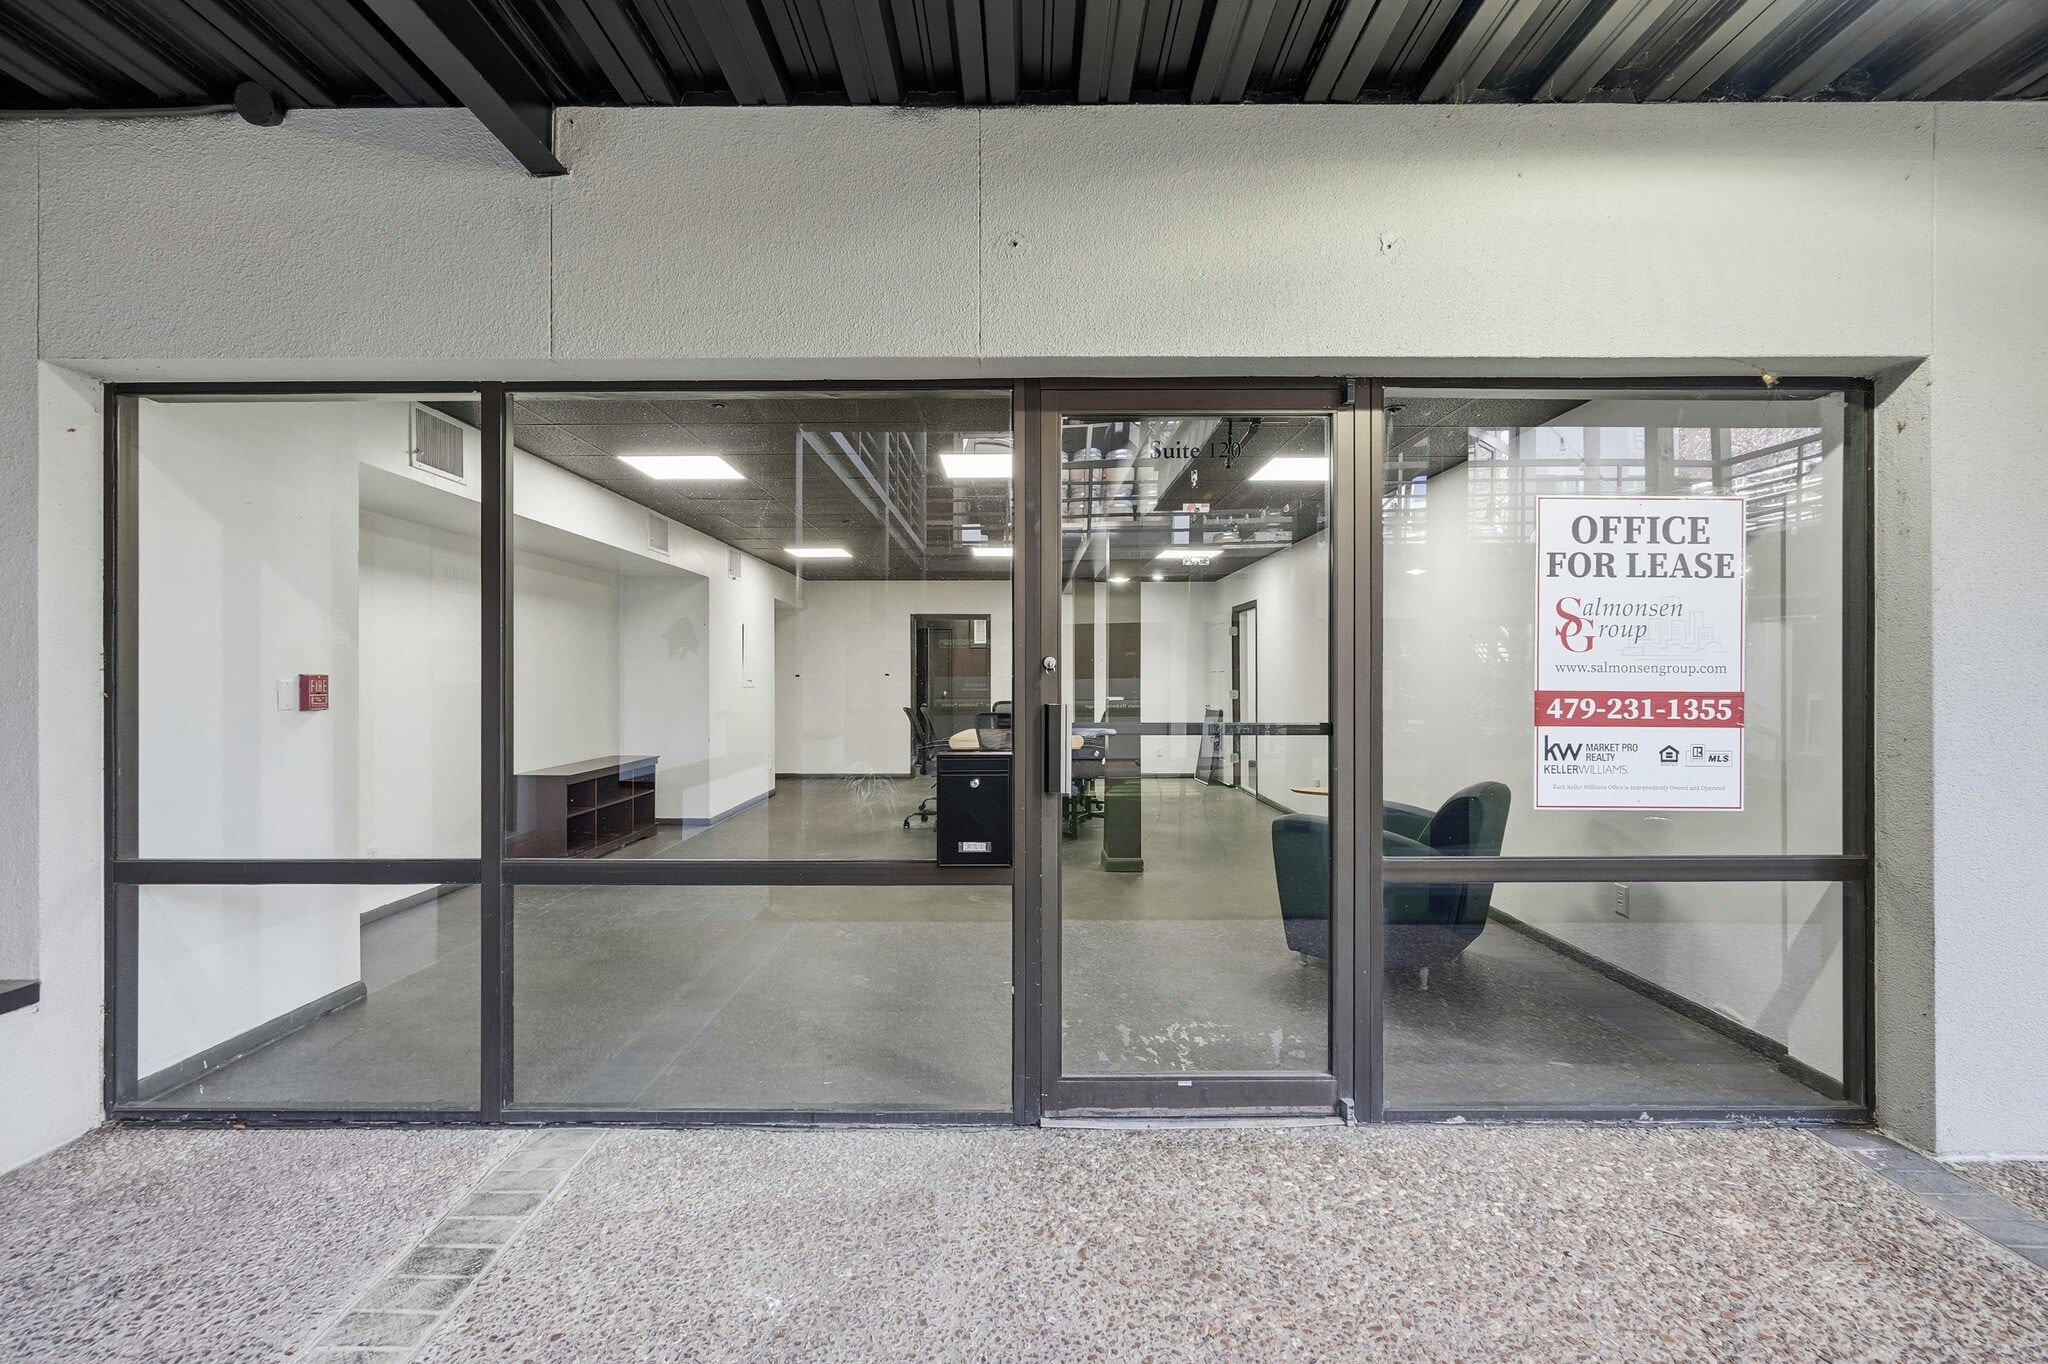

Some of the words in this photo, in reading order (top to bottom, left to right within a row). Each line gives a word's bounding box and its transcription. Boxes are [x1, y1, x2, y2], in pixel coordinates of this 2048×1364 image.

[1150, 440, 1201, 459] Suite
[1209, 441, 1242, 459] 120
[1571, 515, 1711, 545] OFFICE
[1546, 552, 1618, 579] FOR
[1626, 552, 1735, 579] LEASE
[1555, 596, 1684, 637] Salmonsen
[1560, 617, 1648, 653] Group
[1555, 661, 1728, 677] www.salmonsengroup.com
[1546, 698, 1733, 720] 479-231-1355
[1544, 735, 1584, 762] kw
[1585, 743, 1620, 752] MARKET
[1621, 743, 1639, 752] PRO
[1585, 752, 1616, 762] REALTY
[1708, 754, 1730, 763] MLS
